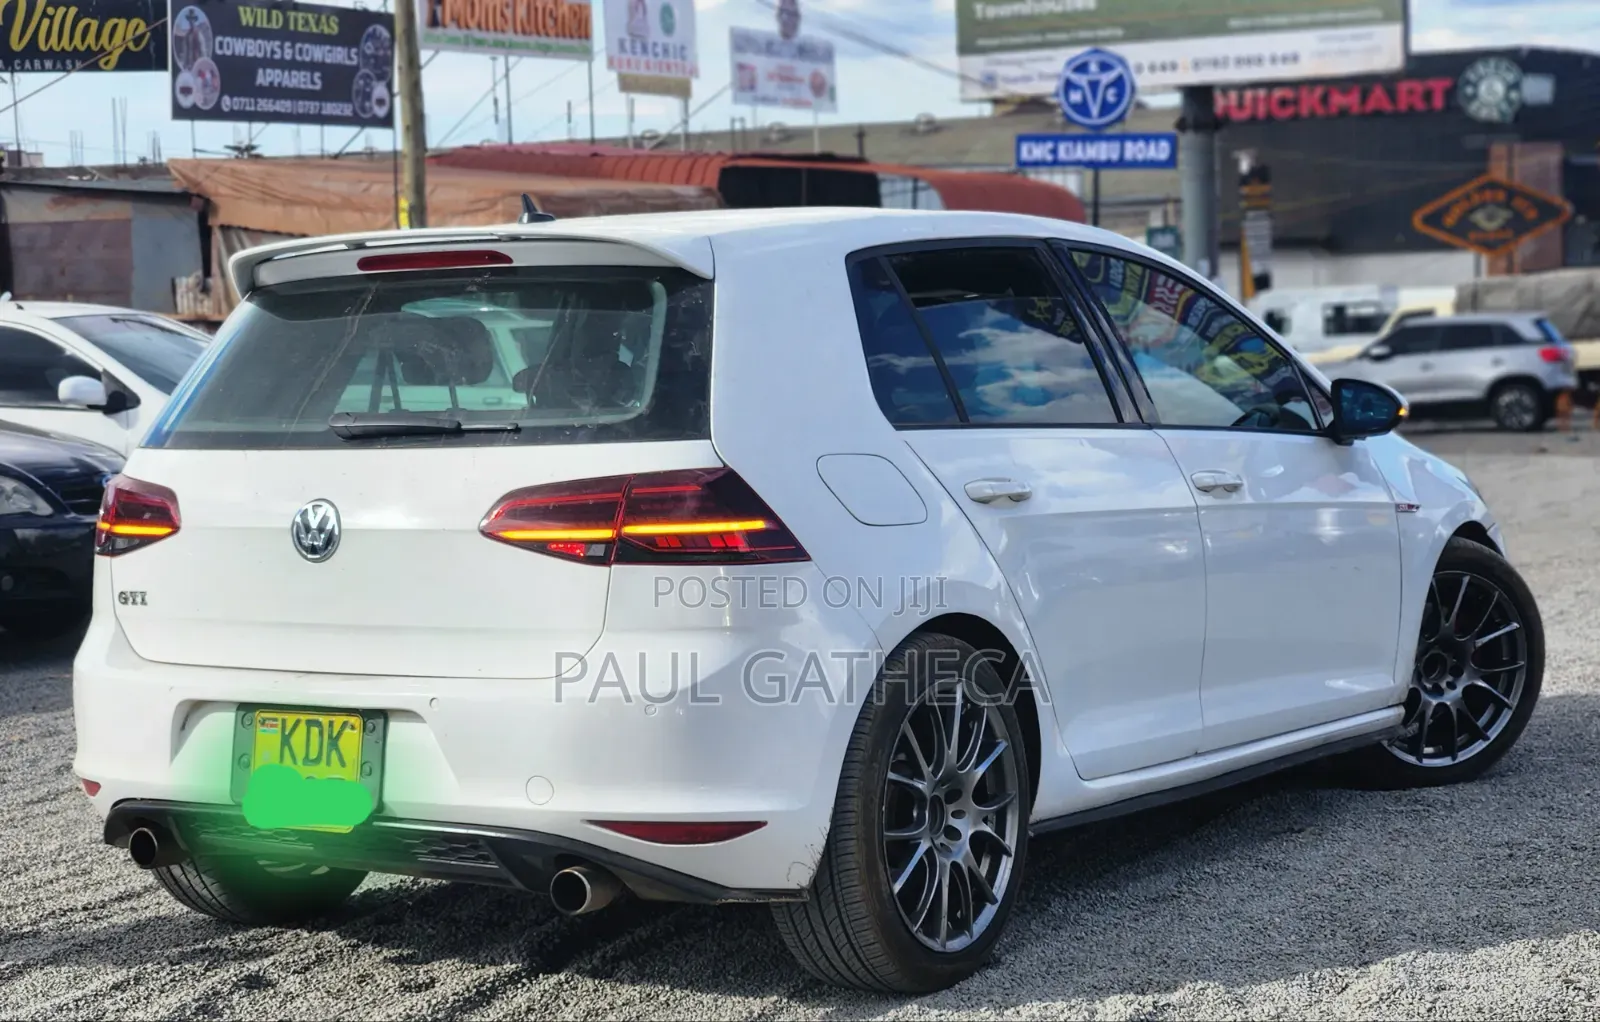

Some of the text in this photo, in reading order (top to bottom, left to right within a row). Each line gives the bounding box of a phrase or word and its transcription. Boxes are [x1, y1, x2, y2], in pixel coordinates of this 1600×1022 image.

[0, 0, 150, 70] Village
[238, 6, 340, 35] WILD TEXAS
[214, 36, 359, 66] COWBOYS & COWGIRLS
[255, 68, 322, 90] APPARELS
[1020, 140, 1171, 162] KMC KIAMBU ROAD
[279, 717, 347, 769] KDK
